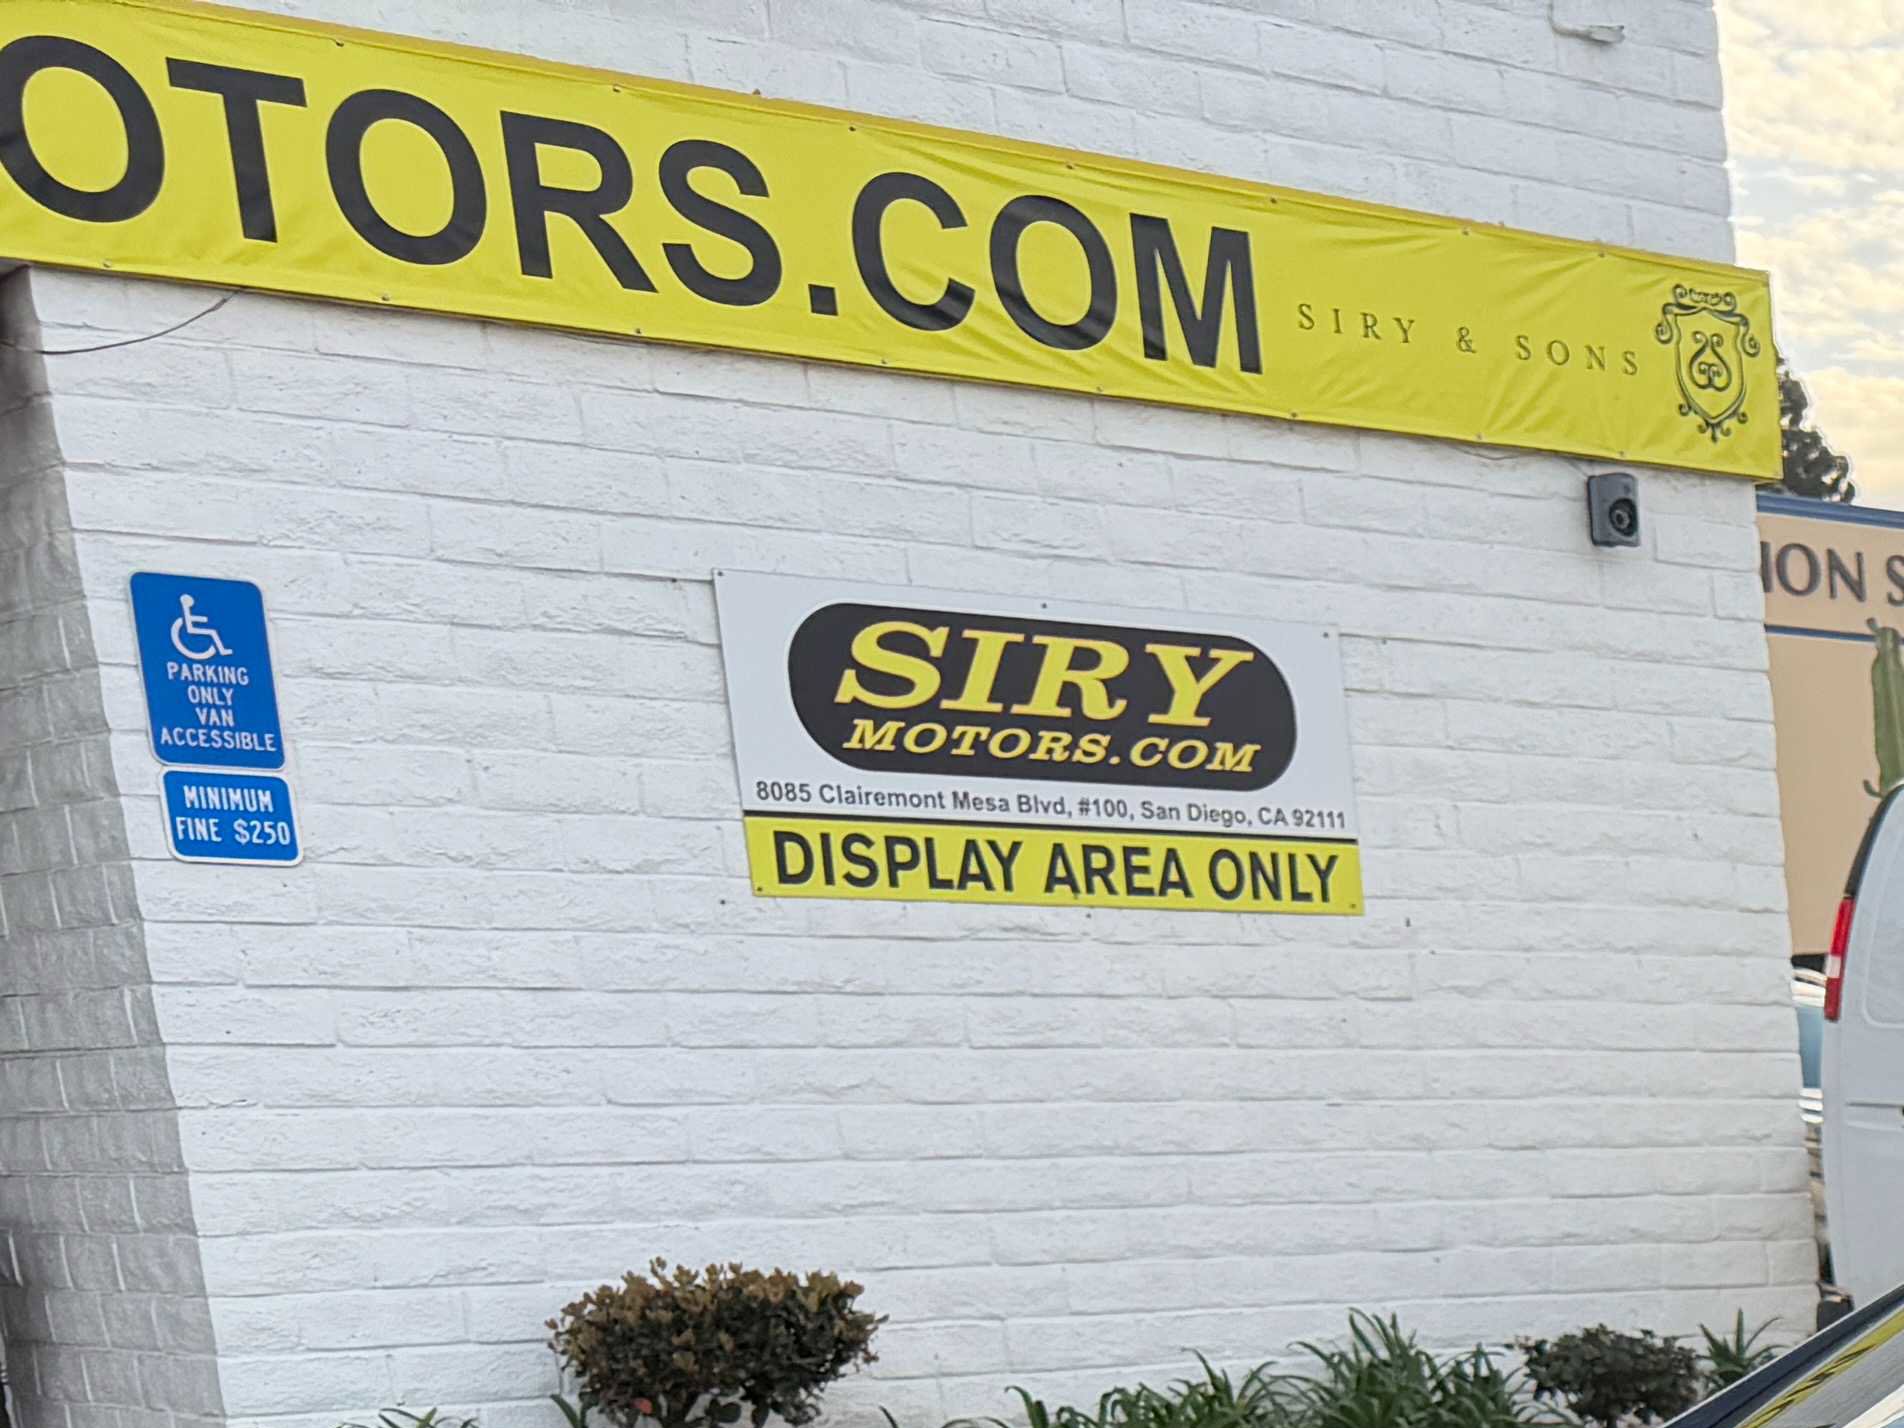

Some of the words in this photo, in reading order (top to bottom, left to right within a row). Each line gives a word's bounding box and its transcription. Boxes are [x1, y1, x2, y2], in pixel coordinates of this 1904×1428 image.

[1298, 302, 1418, 345] SIRY
[1455, 327, 1478, 354] &
[1515, 335, 1640, 377] SONS
[166, 661, 249, 687] PARKING
[834, 619, 1255, 728] SIRY
[187, 685, 234, 706] ONLY
[195, 707, 235, 728] VAN
[160, 727, 277, 752] ACCESSIBLE
[841, 717, 1262, 774] MOTORS.COM
[183, 785, 275, 813] MINIMUM
[755, 780, 813, 805] 8085
[818, 783, 946, 811] Clairemont
[950, 789, 1011, 815] Mesa
[1016, 793, 1074, 819] Blvd,
[1077, 797, 1136, 823] #100,
[1140, 799, 1182, 822] San
[1185, 803, 1254, 829] Diego,
[1257, 806, 1290, 828] CA
[1291, 807, 1347, 830] 92111
[175, 816, 223, 843] FINE
[233, 818, 292, 846] $250
[772, 829, 1023, 893] DISPLAY
[1042, 842, 1195, 899] AREA
[1207, 849, 1340, 905] ONLY
